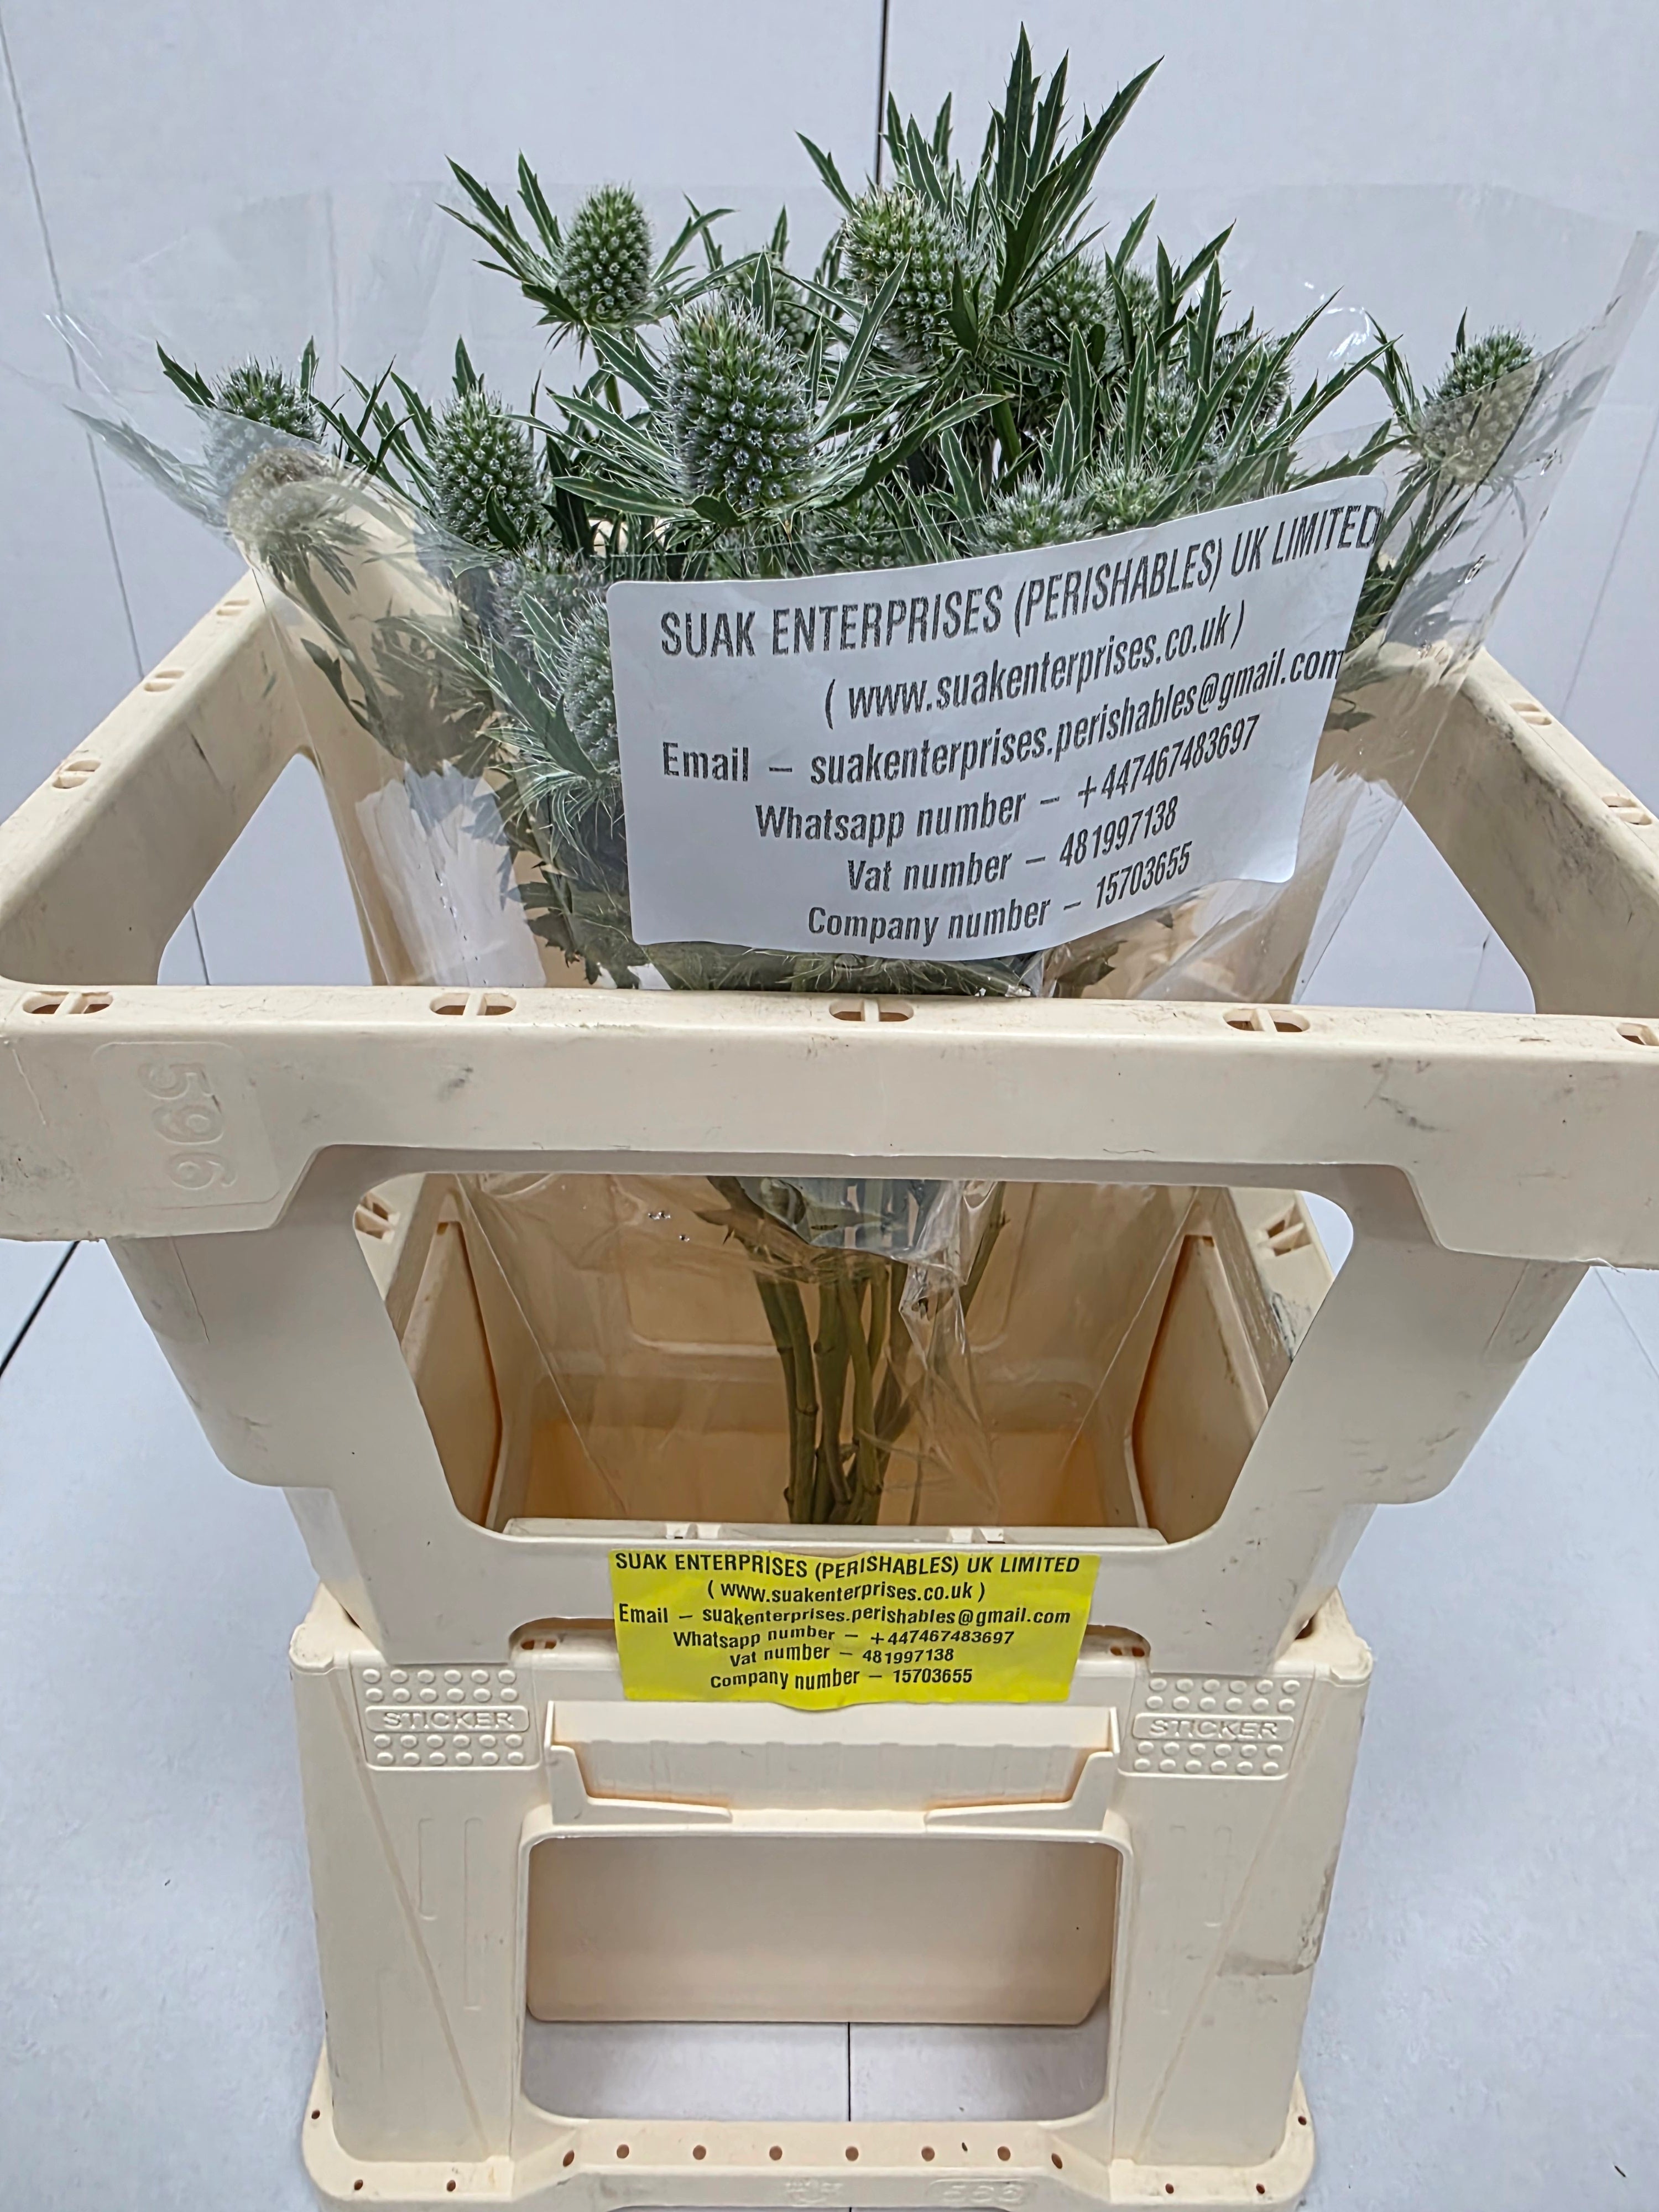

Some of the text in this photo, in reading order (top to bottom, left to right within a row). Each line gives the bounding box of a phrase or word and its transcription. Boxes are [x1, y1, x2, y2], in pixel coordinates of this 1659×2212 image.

[661, 504, 1383, 658] SUAK ENTERPRISES (PERISHABLES) UK LIMITED
[848, 604, 1231, 719] www.suakenterprises.co.uk
[662, 741, 749, 782] Email
[810, 648, 1344, 785] suakenterprises.perishables@gmail.com
[755, 805, 905, 848] Whatsapp
[916, 791, 1026, 837] number
[1078, 714, 1260, 808] +447467483697
[847, 859, 892, 892] Vat
[904, 852, 1013, 891] number
[1059, 795, 1178, 867] 481997138
[808, 906, 940, 947] Company
[948, 898, 1051, 940] number
[1097, 841, 1193, 909] 15703655
[615, 1552, 1080, 1582] SUAK ENTERPRISES (PERISHABLES) UK LIMITED
[721, 1582, 973, 1603] www.suakenterprises.co.uk
[619, 1603, 668, 1623] Email
[702, 1605, 1071, 1627] suakenterprises.perishables@gmail.com
[673, 1631, 760, 1650] Whatsapp
[768, 1625, 836, 1641] number
[870, 1630, 1015, 1645] +447467483697
[729, 1651, 757, 1667] Vat
[764, 1643, 830, 1661] number
[862, 1648, 954, 1665] 481997138
[711, 1671, 789, 1690] Company
[795, 1668, 860, 1691] number
[893, 1668, 973, 1683] 15703655
[383, 1711, 514, 1729] STICKER
[1149, 1719, 1279, 1739] STICKER
